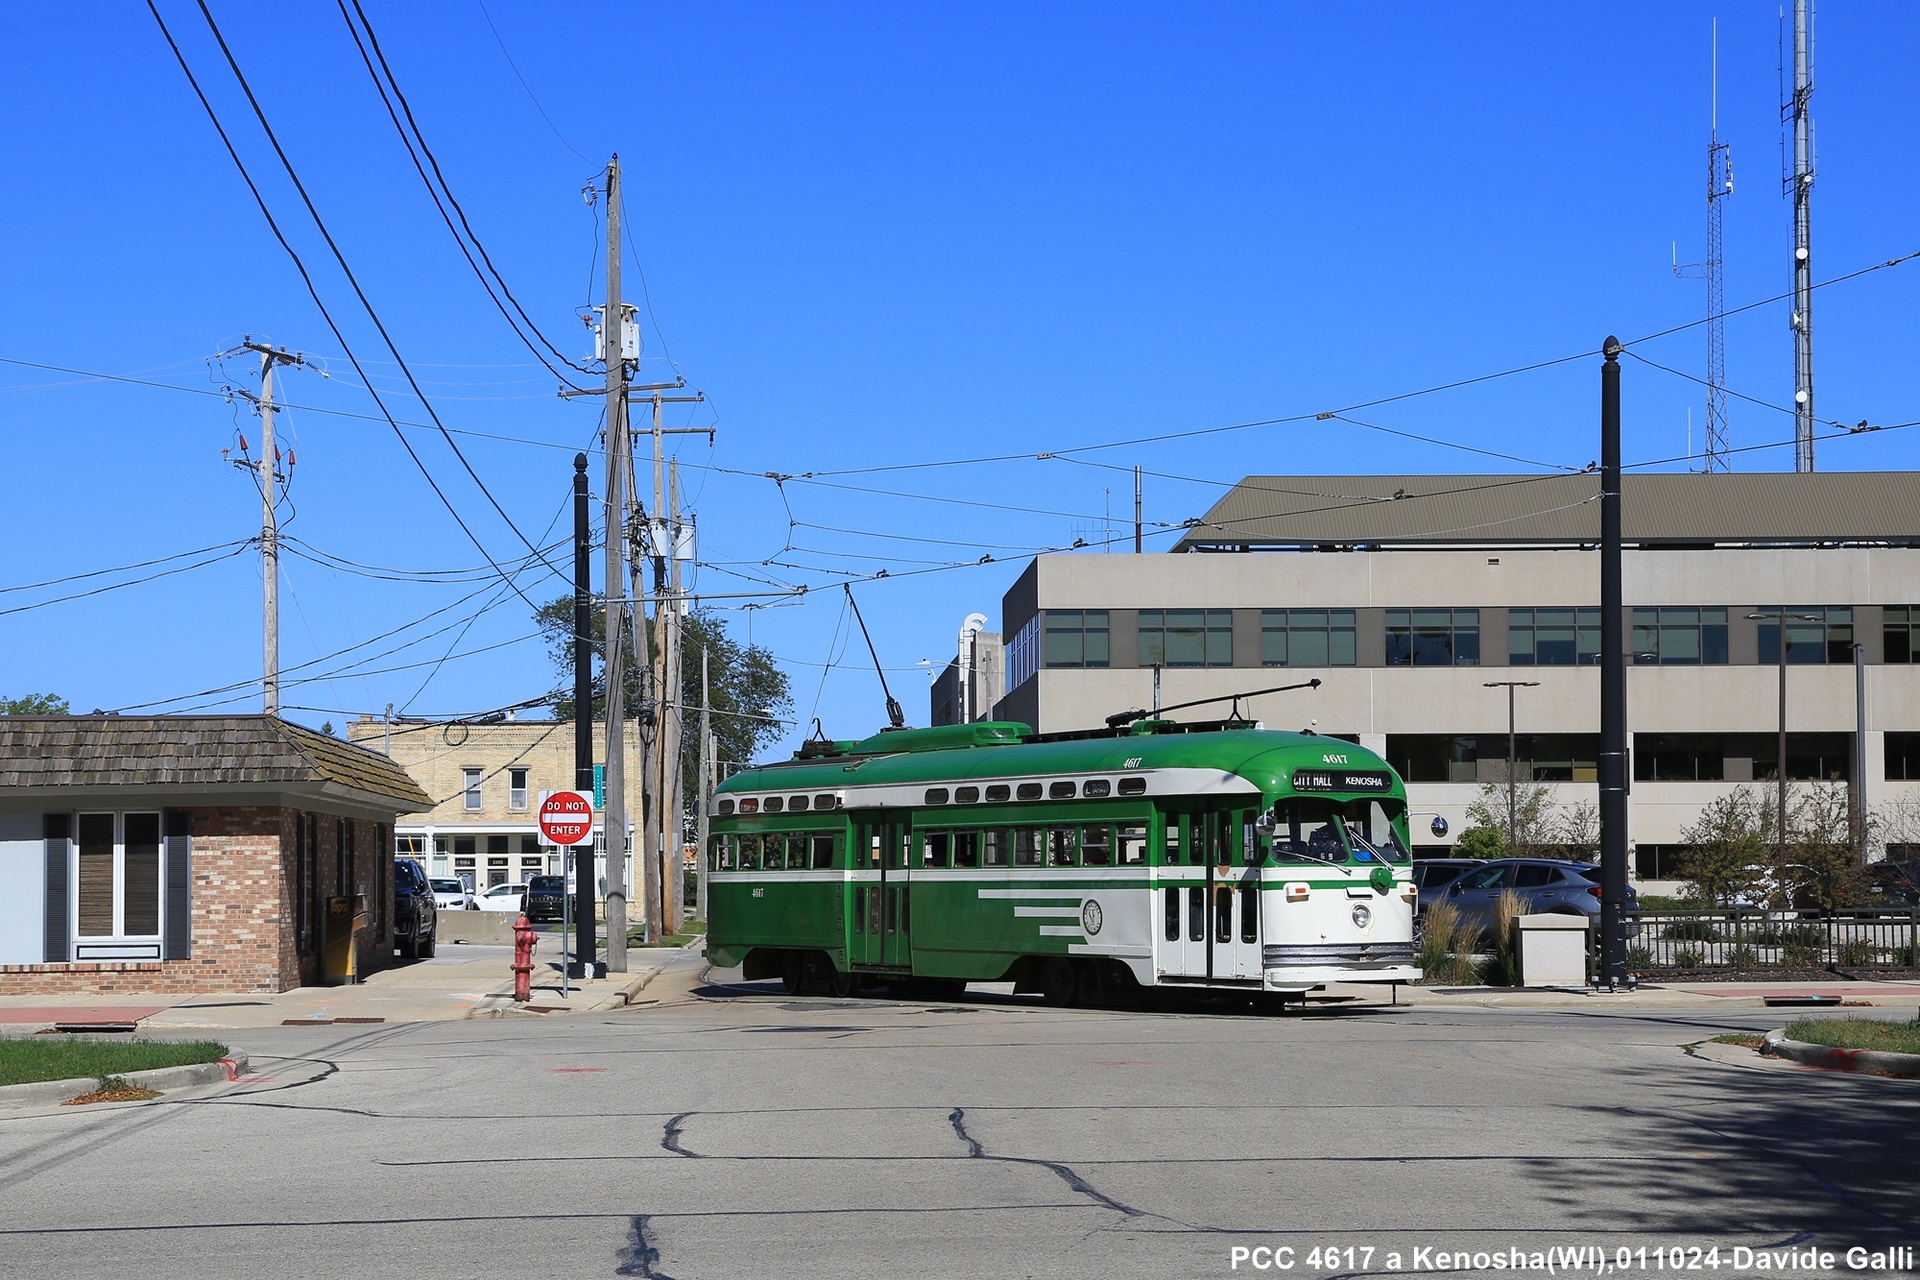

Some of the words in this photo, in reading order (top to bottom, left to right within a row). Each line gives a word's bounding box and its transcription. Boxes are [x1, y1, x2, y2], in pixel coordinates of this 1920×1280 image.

[1123, 757, 1143, 768] 4617
[1322, 754, 1348, 764] 4617
[1293, 773, 1312, 786] CITY
[1313, 774, 1332, 786] HALL
[1345, 777, 1383, 787] KENOSHA
[547, 802, 560, 810] DO
[566, 802, 585, 810] NOT
[550, 826, 581, 834] ENTER
[752, 888, 764, 898] 4617
